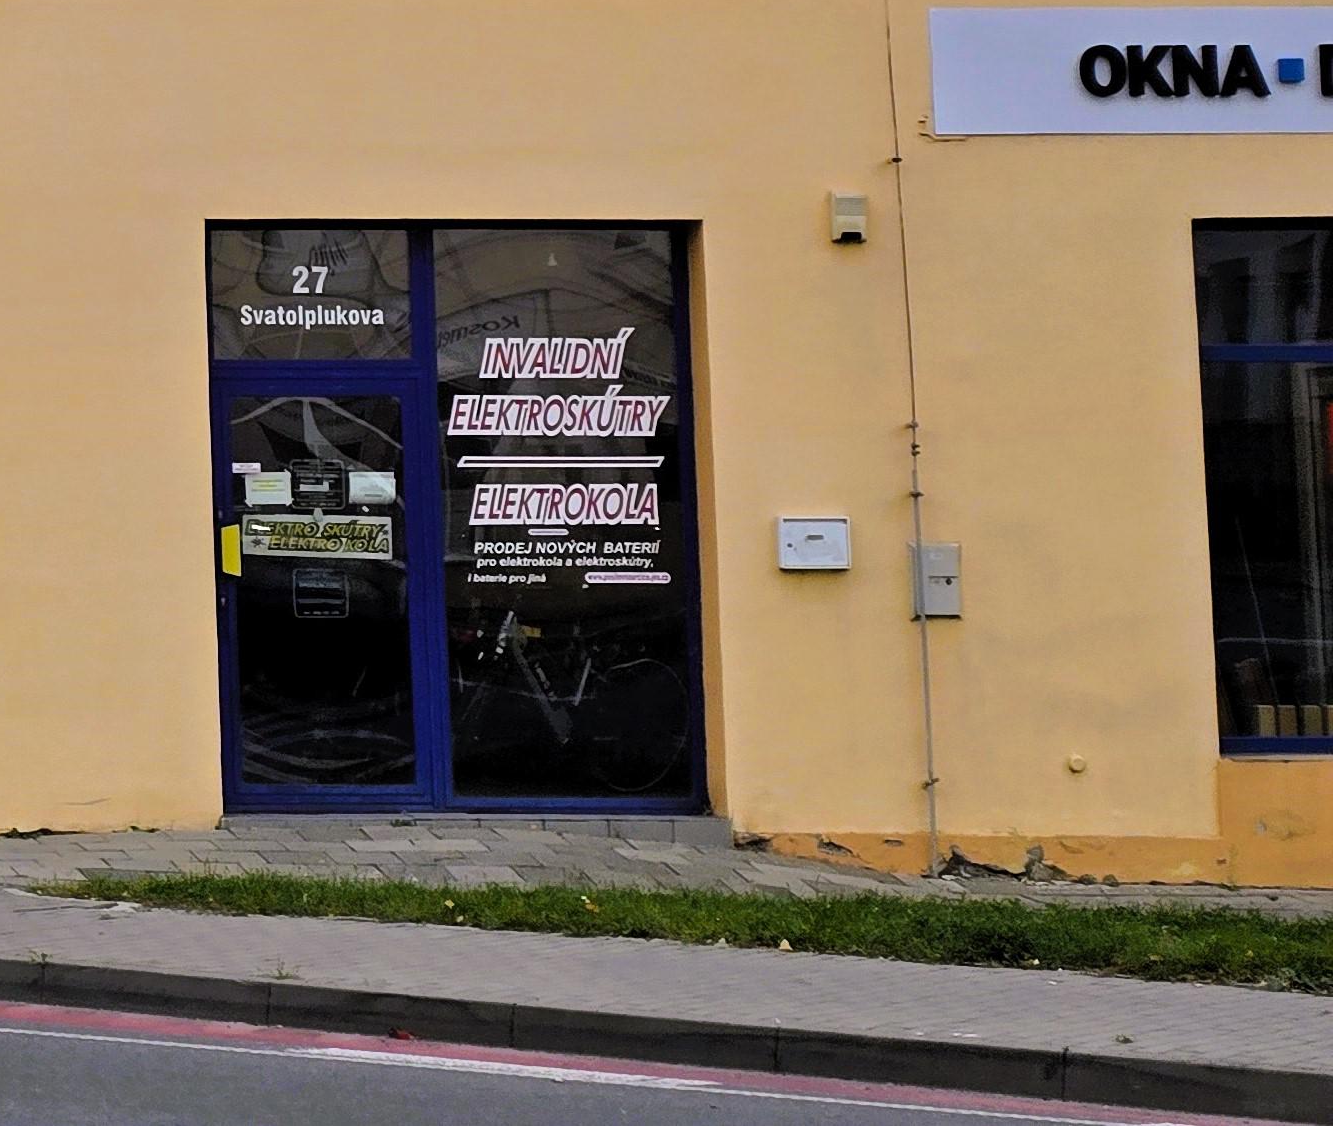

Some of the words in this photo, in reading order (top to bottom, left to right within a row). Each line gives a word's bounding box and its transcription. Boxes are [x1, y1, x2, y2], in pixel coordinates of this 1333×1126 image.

[1079, 44, 1272, 98] OKNA
[292, 265, 329, 294] 27
[240, 304, 385, 330] Svatolplukova
[479, 327, 635, 379] INVALIDNÍ
[447, 385, 671, 437] ELEKTROSKÚTRY
[469, 483, 660, 526] ELEKTROKOLA
[268, 535, 343, 553] ELEKTRO
[343, 538, 390, 554] KOLA
[474, 541, 532, 555] PRODEJ
[535, 539, 597, 555] NOVÝCH
[476, 558, 497, 568] pro
[499, 556, 563, 567] elektrokola
[565, 558, 573, 567] a
[508, 574, 527, 585] pro
